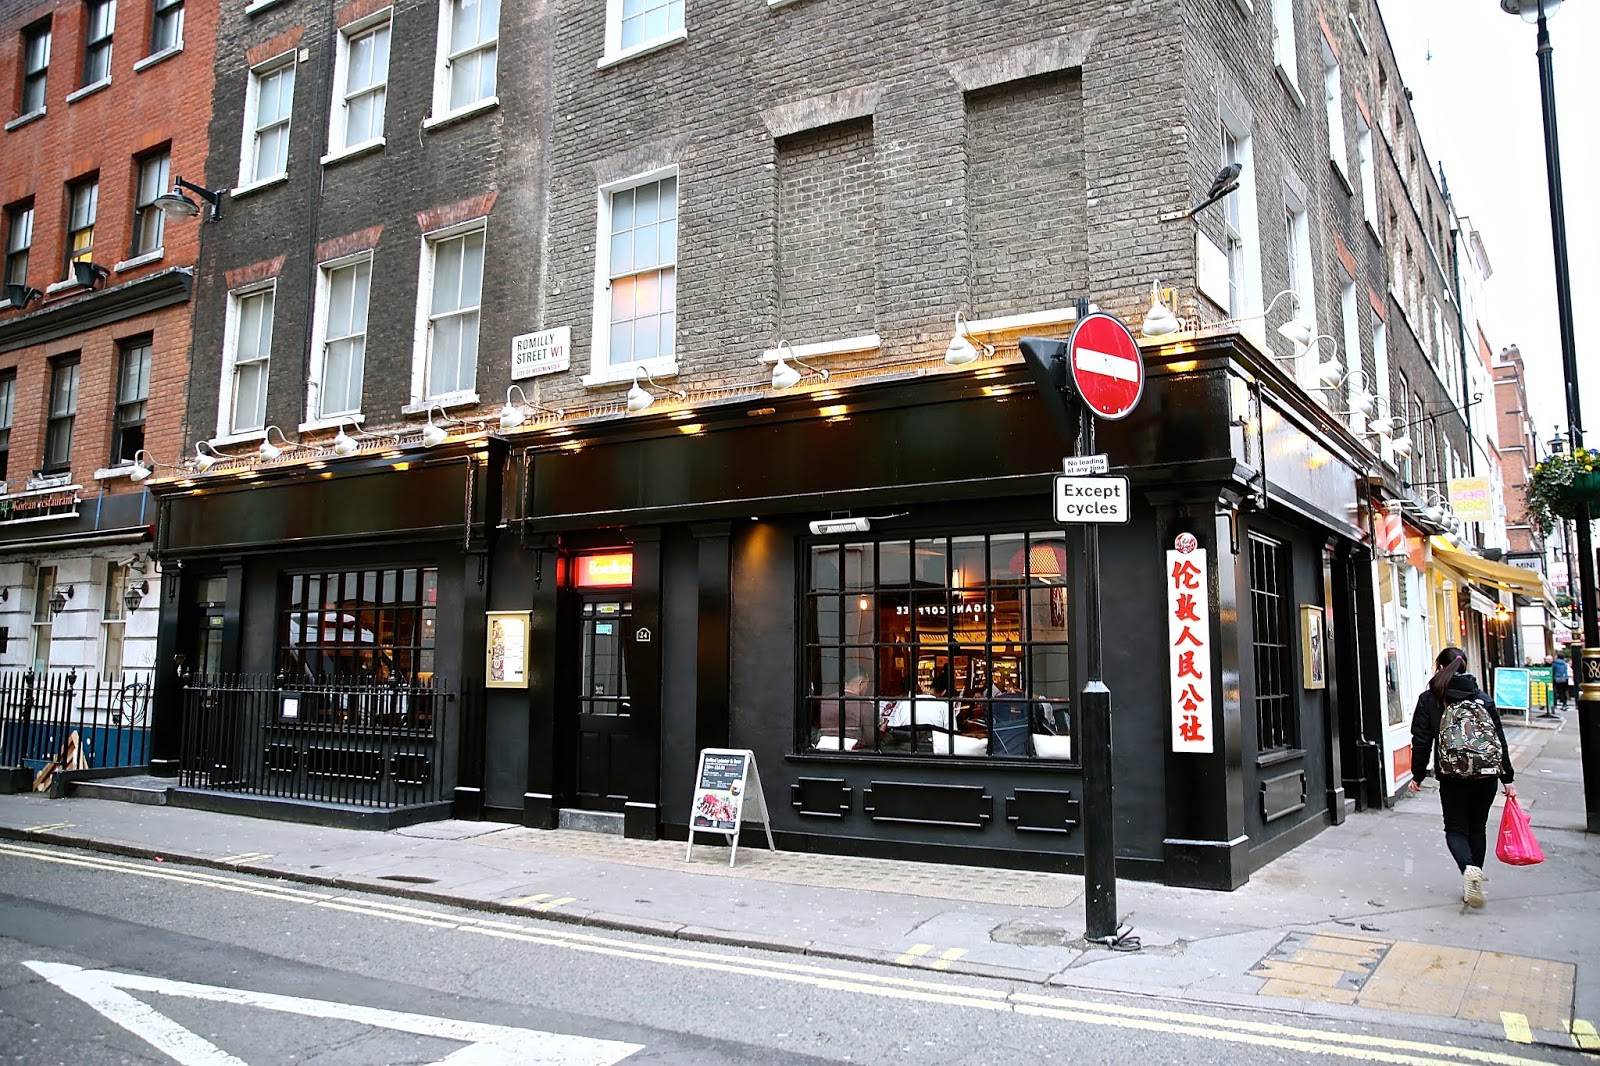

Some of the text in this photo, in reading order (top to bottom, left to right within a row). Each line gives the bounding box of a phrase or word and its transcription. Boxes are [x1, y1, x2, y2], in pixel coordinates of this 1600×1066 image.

[517, 334, 555, 351] ROMILLY
[516, 345, 563, 365] STREET W1
[532, 363, 561, 374] WESTMINSTER
[1079, 458, 1104, 466] loading
[1064, 484, 1121, 500] Except
[13, 500, 36, 511] Korean
[39, 496, 73, 508] restaurant
[1066, 501, 1118, 517] cycles
[639, 631, 648, 639] 24
[1171, 559, 1205, 743] 伦敦人民公社
